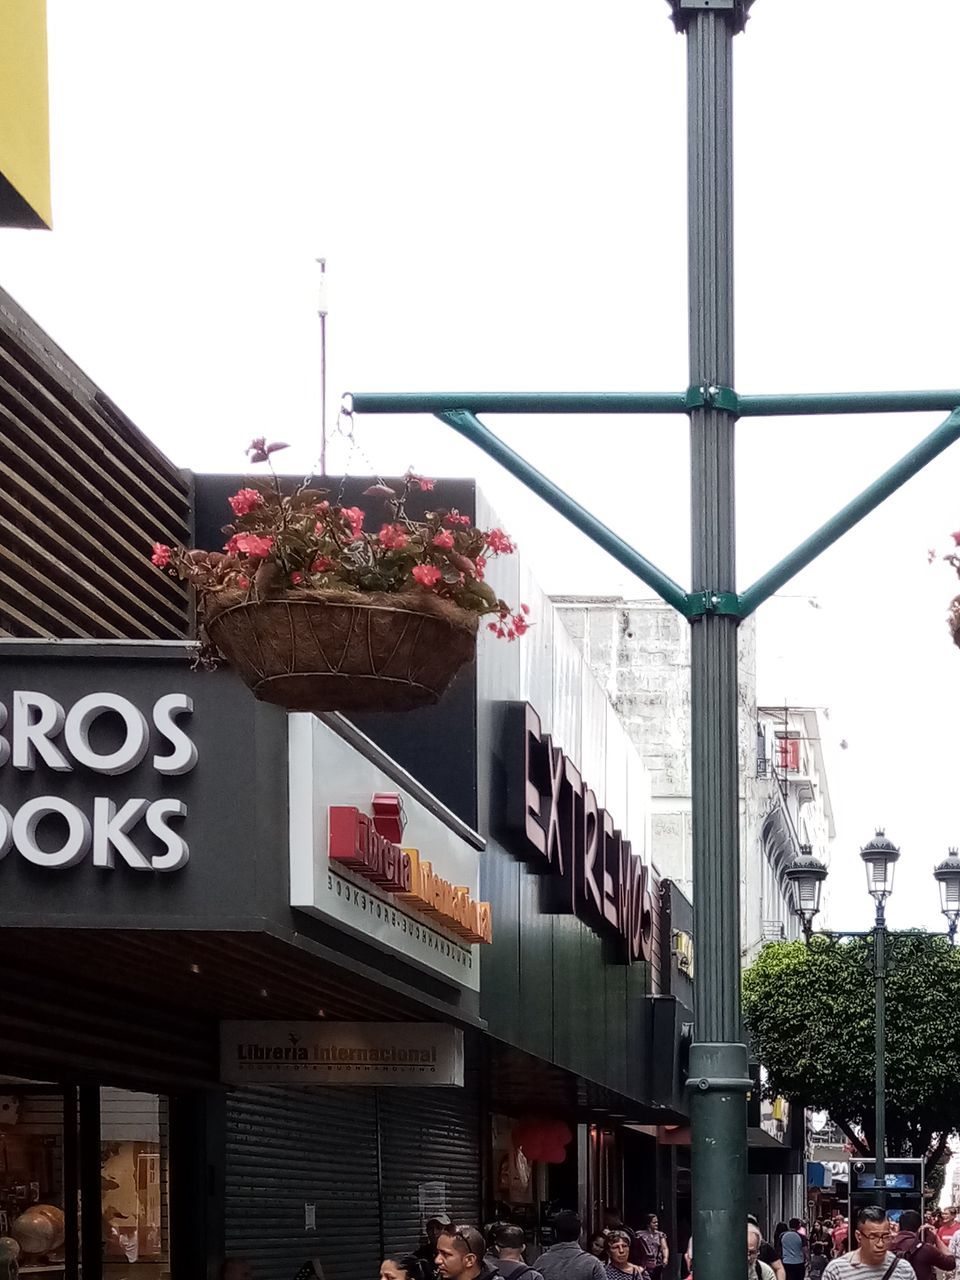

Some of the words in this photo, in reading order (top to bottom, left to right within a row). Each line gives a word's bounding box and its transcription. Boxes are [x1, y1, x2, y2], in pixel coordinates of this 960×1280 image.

[0, 690, 198, 776] ROS
[0, 795, 190, 873] OKS
[525, 700, 652, 966] EXTREMOS
